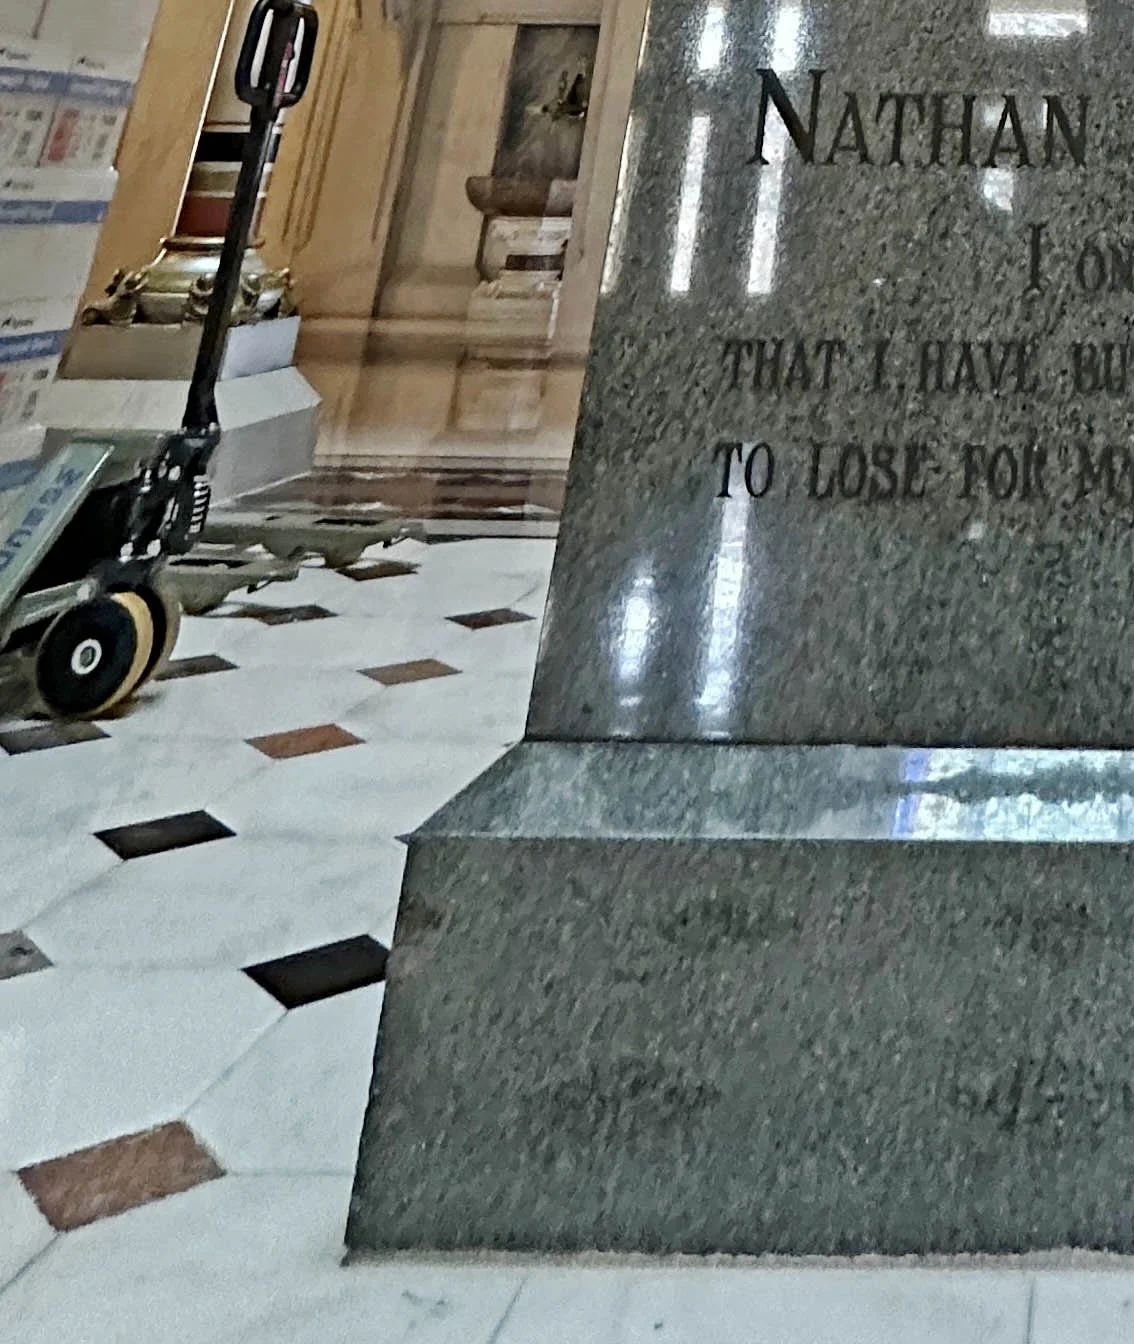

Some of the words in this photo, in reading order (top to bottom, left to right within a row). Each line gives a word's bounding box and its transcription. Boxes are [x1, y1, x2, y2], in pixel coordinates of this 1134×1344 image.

[745, 67, 1091, 169] NATHAN
[1021, 222, 1048, 293] I
[722, 338, 848, 392] THAT
[872, 339, 891, 391] I
[919, 339, 1040, 395] HAVE
[712, 440, 775, 499] TO
[806, 441, 934, 502] LOSE
[958, 444, 1049, 502] FOR
